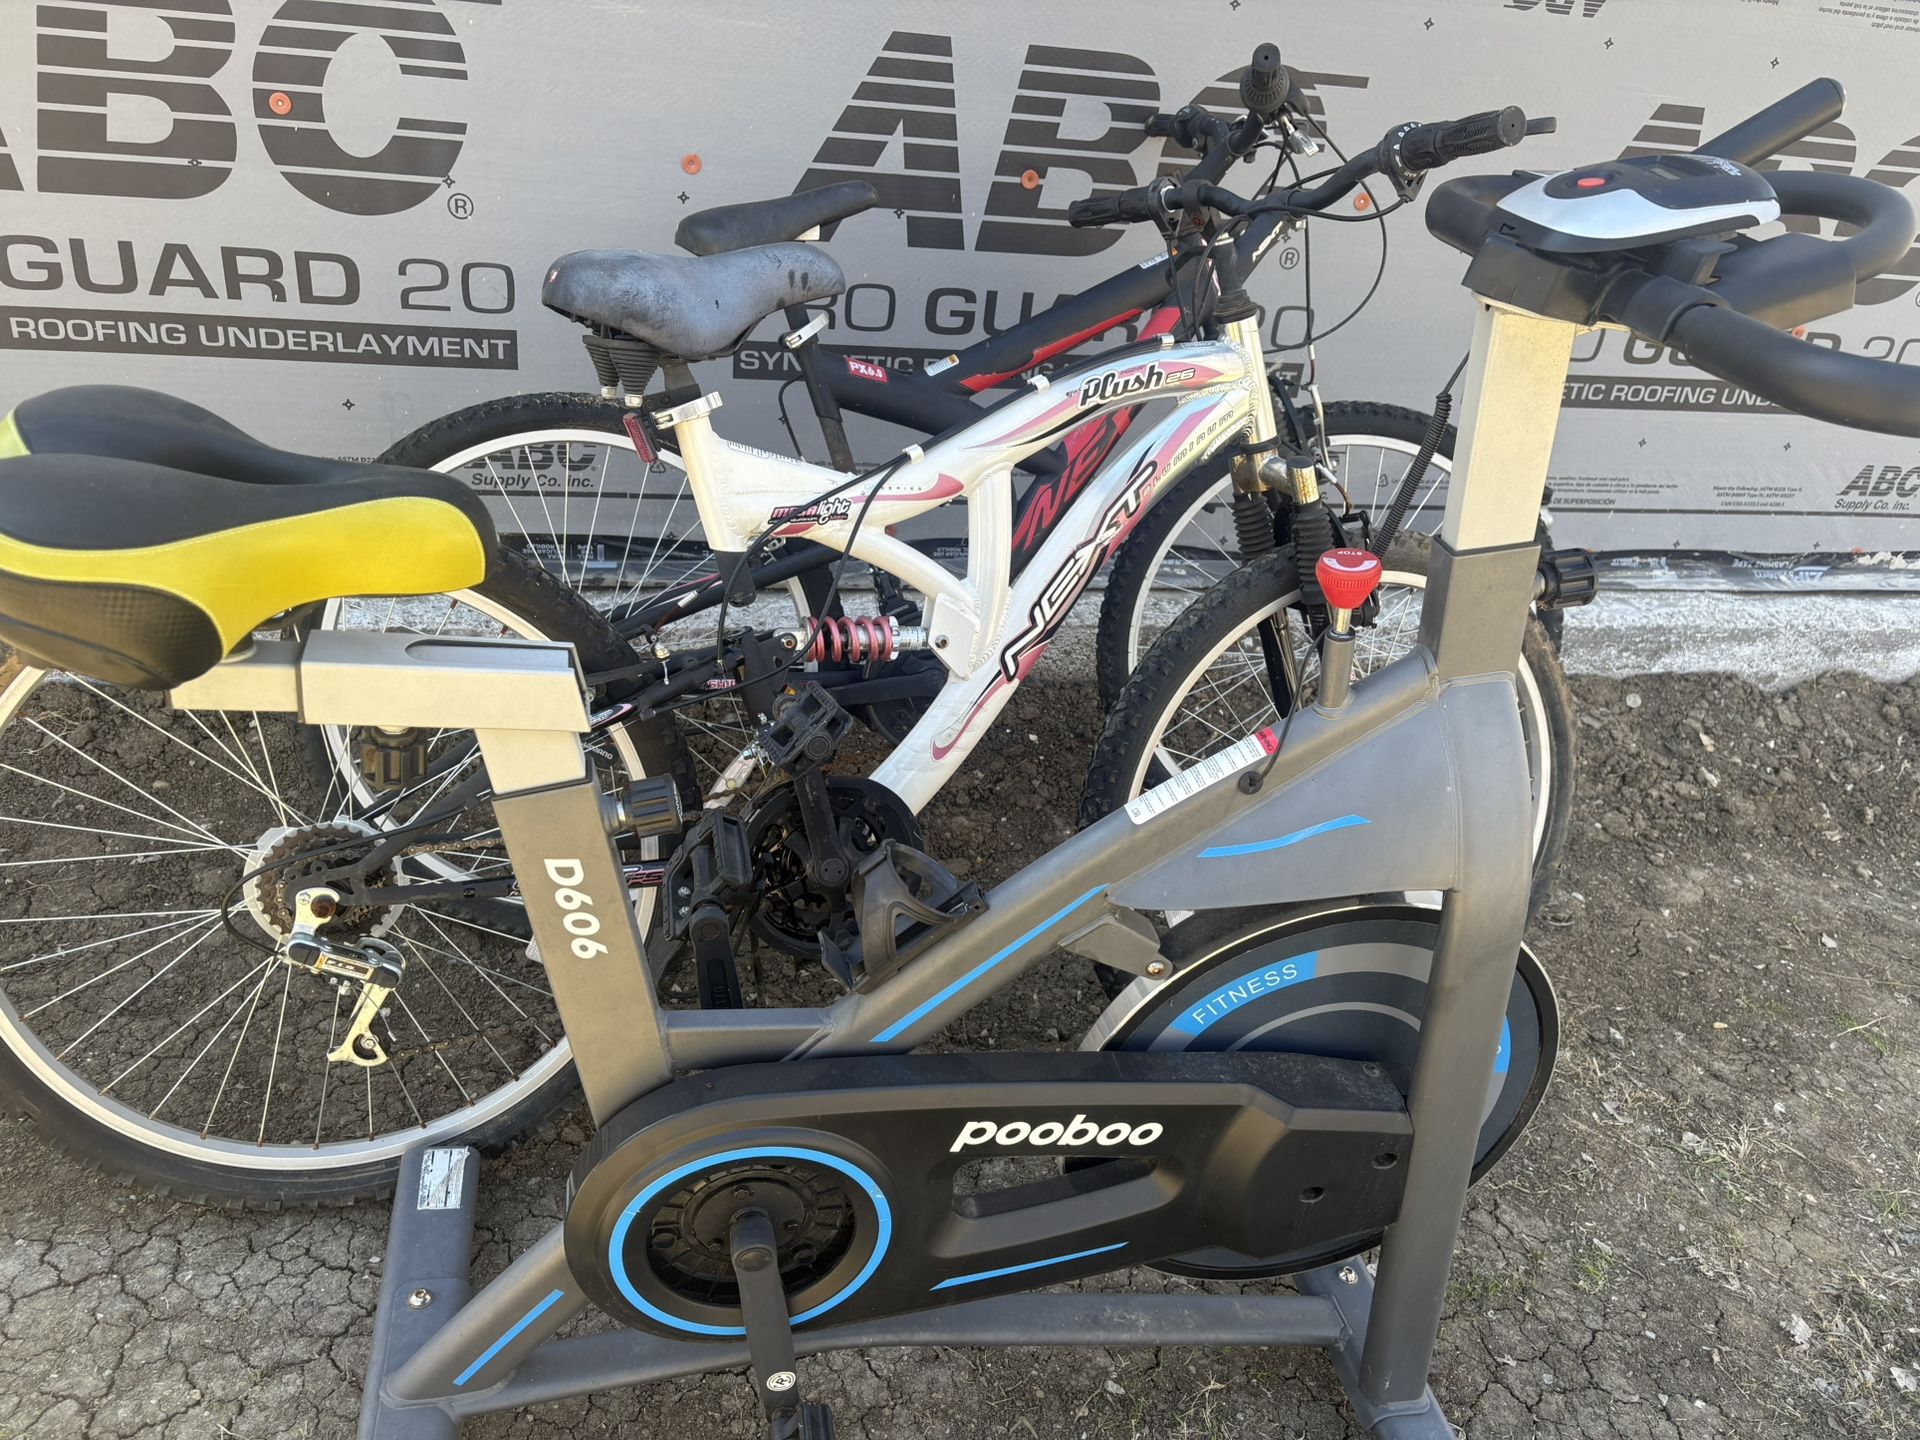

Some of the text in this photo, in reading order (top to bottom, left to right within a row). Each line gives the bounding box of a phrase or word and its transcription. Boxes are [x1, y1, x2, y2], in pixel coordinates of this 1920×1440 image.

[0, 0, 468, 216] BC
[0, 235, 515, 314] GUARD 20
[10, 317, 511, 360] ROOFING UNDERLAYMENT
[1078, 360, 1160, 406] Plush
[1610, 385, 1717, 405] ROOFING
[471, 472, 531, 489] Supply
[537, 474, 561, 487] Co.
[1835, 465, 1920, 498] ABC
[1834, 499, 1871, 511] Supply
[1873, 500, 1889, 510] Co.
[1001, 460, 1157, 682] NEXT
[543, 858, 608, 960] D606
[1192, 964, 1298, 1025] FITNESS
[950, 1115, 1164, 1152] pooboo
